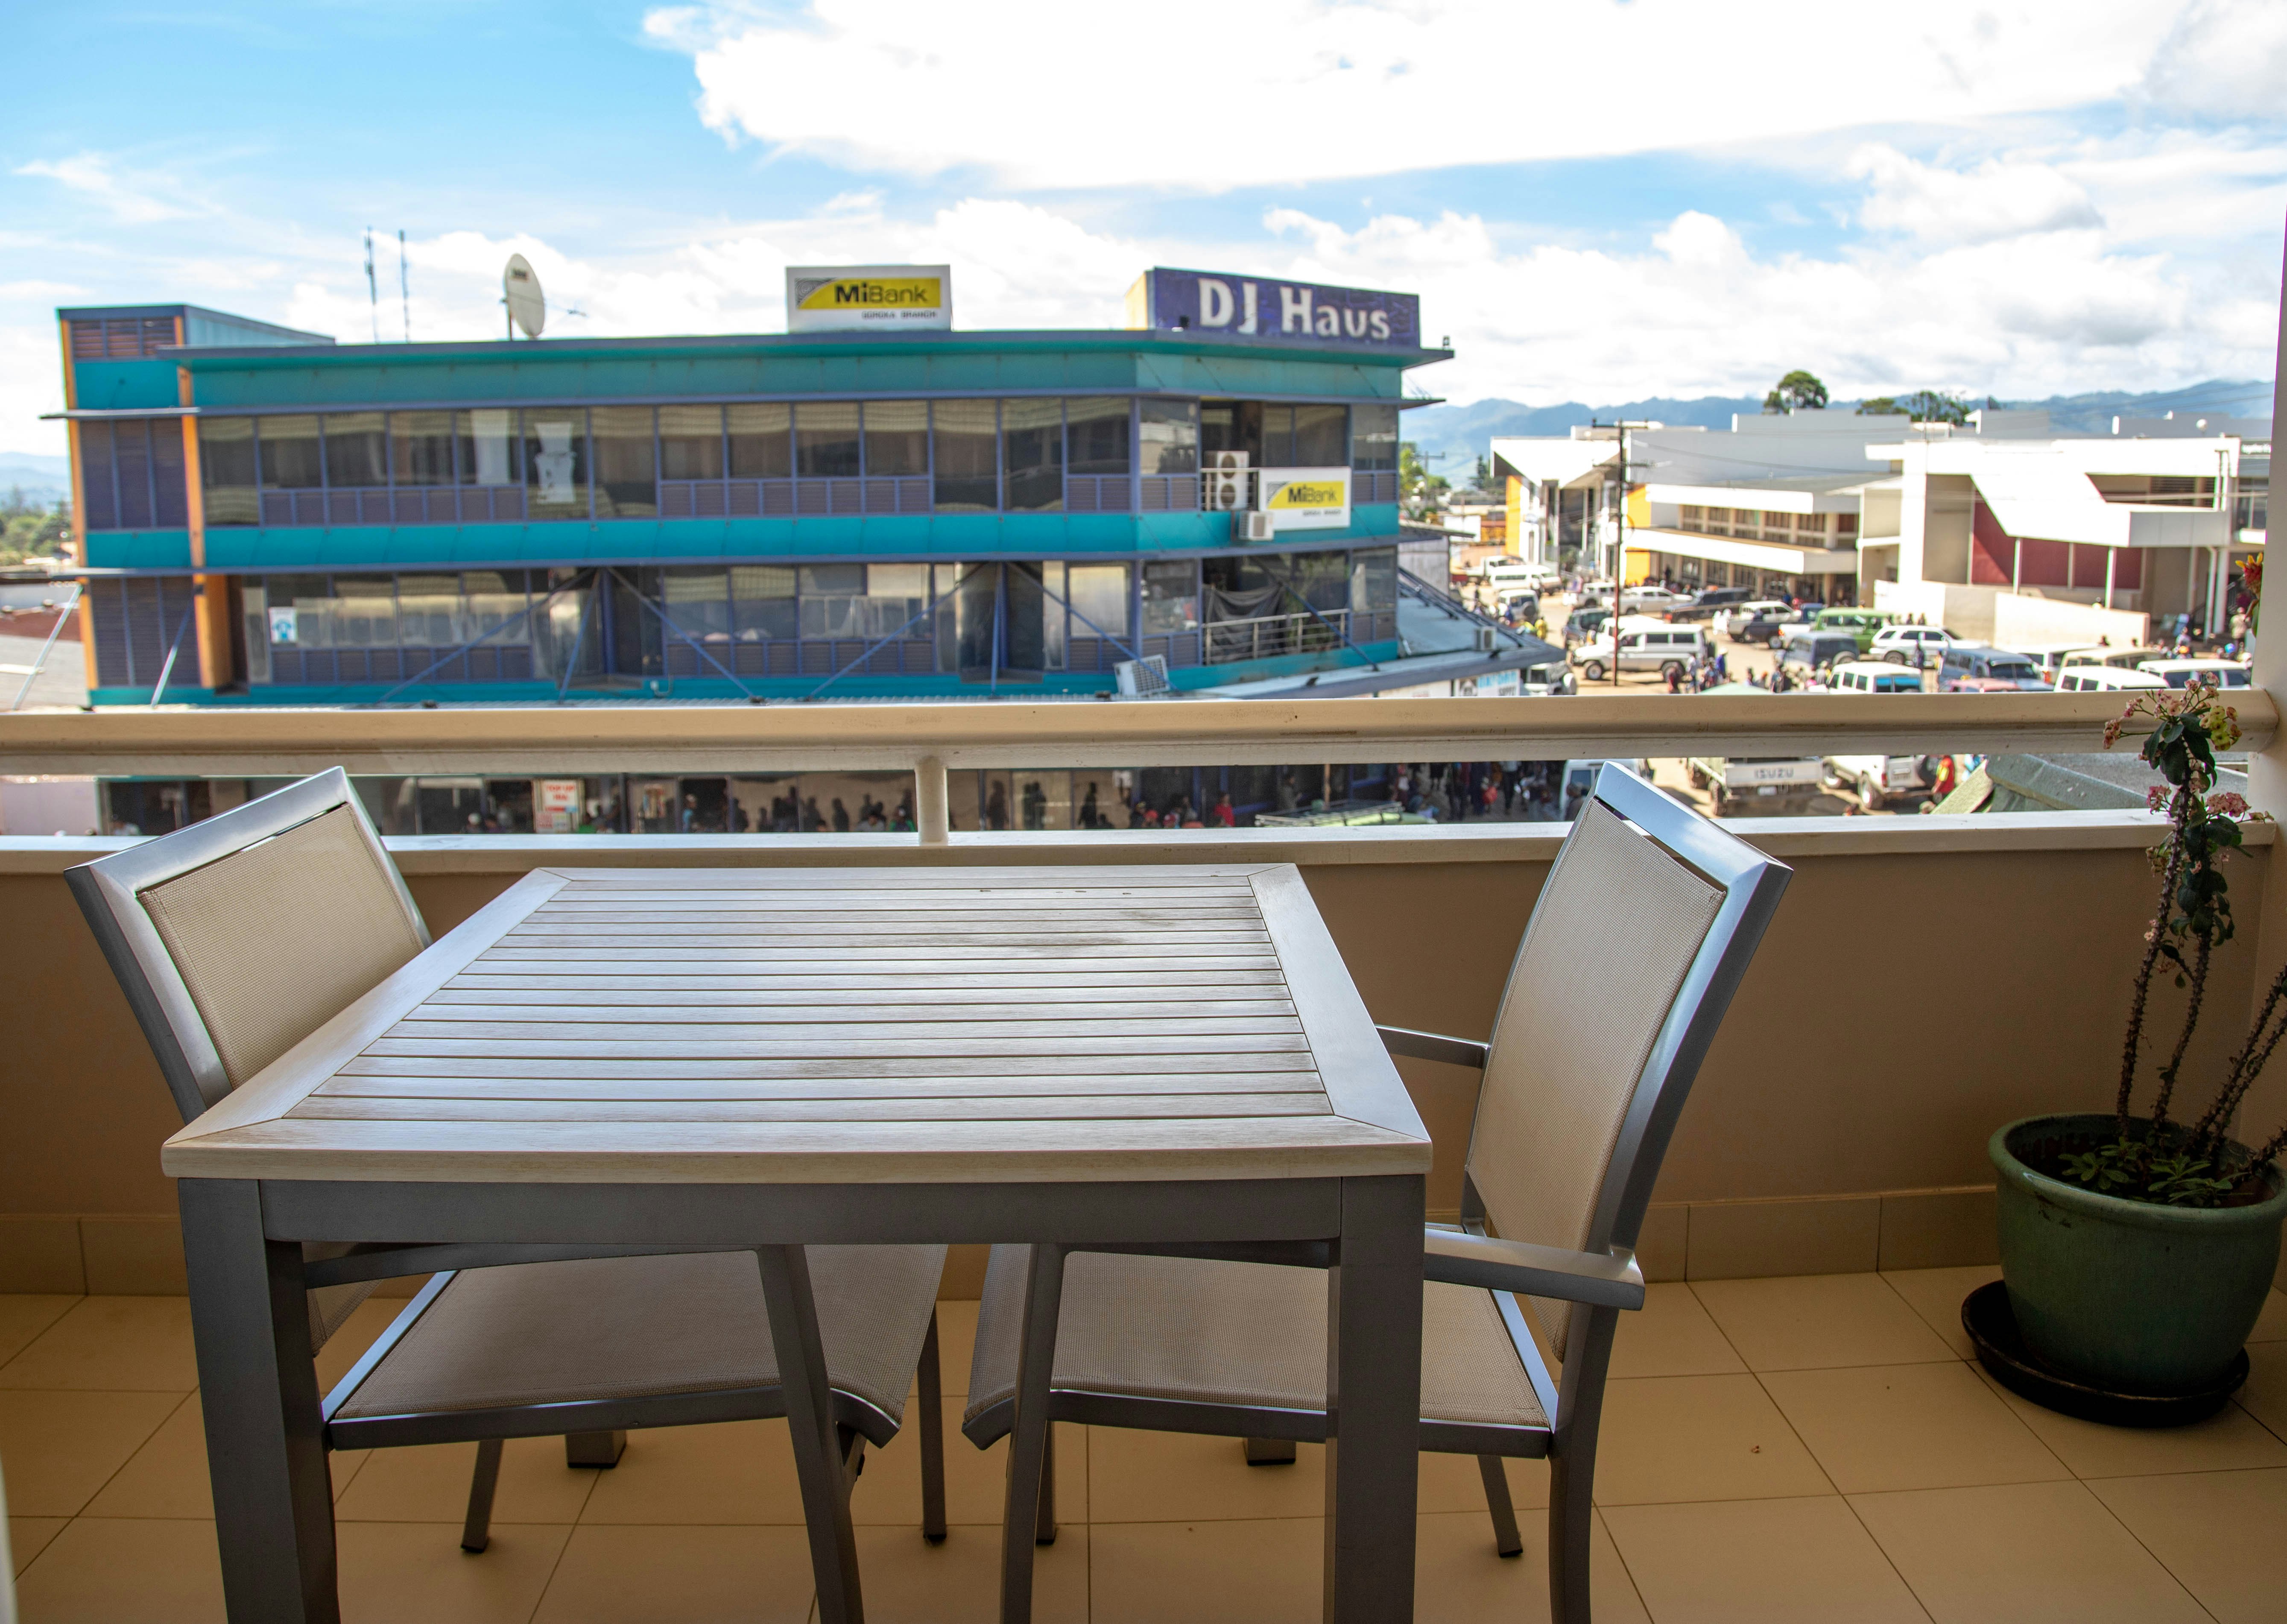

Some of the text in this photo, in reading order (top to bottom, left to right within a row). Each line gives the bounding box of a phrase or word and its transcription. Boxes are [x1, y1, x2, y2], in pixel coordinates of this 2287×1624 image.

[834, 282, 928, 304] MiBank
[1198, 278, 1391, 341] DJ Haus
[1287, 483, 1337, 503] MiBank
[1754, 767, 1794, 779] ISUZU
